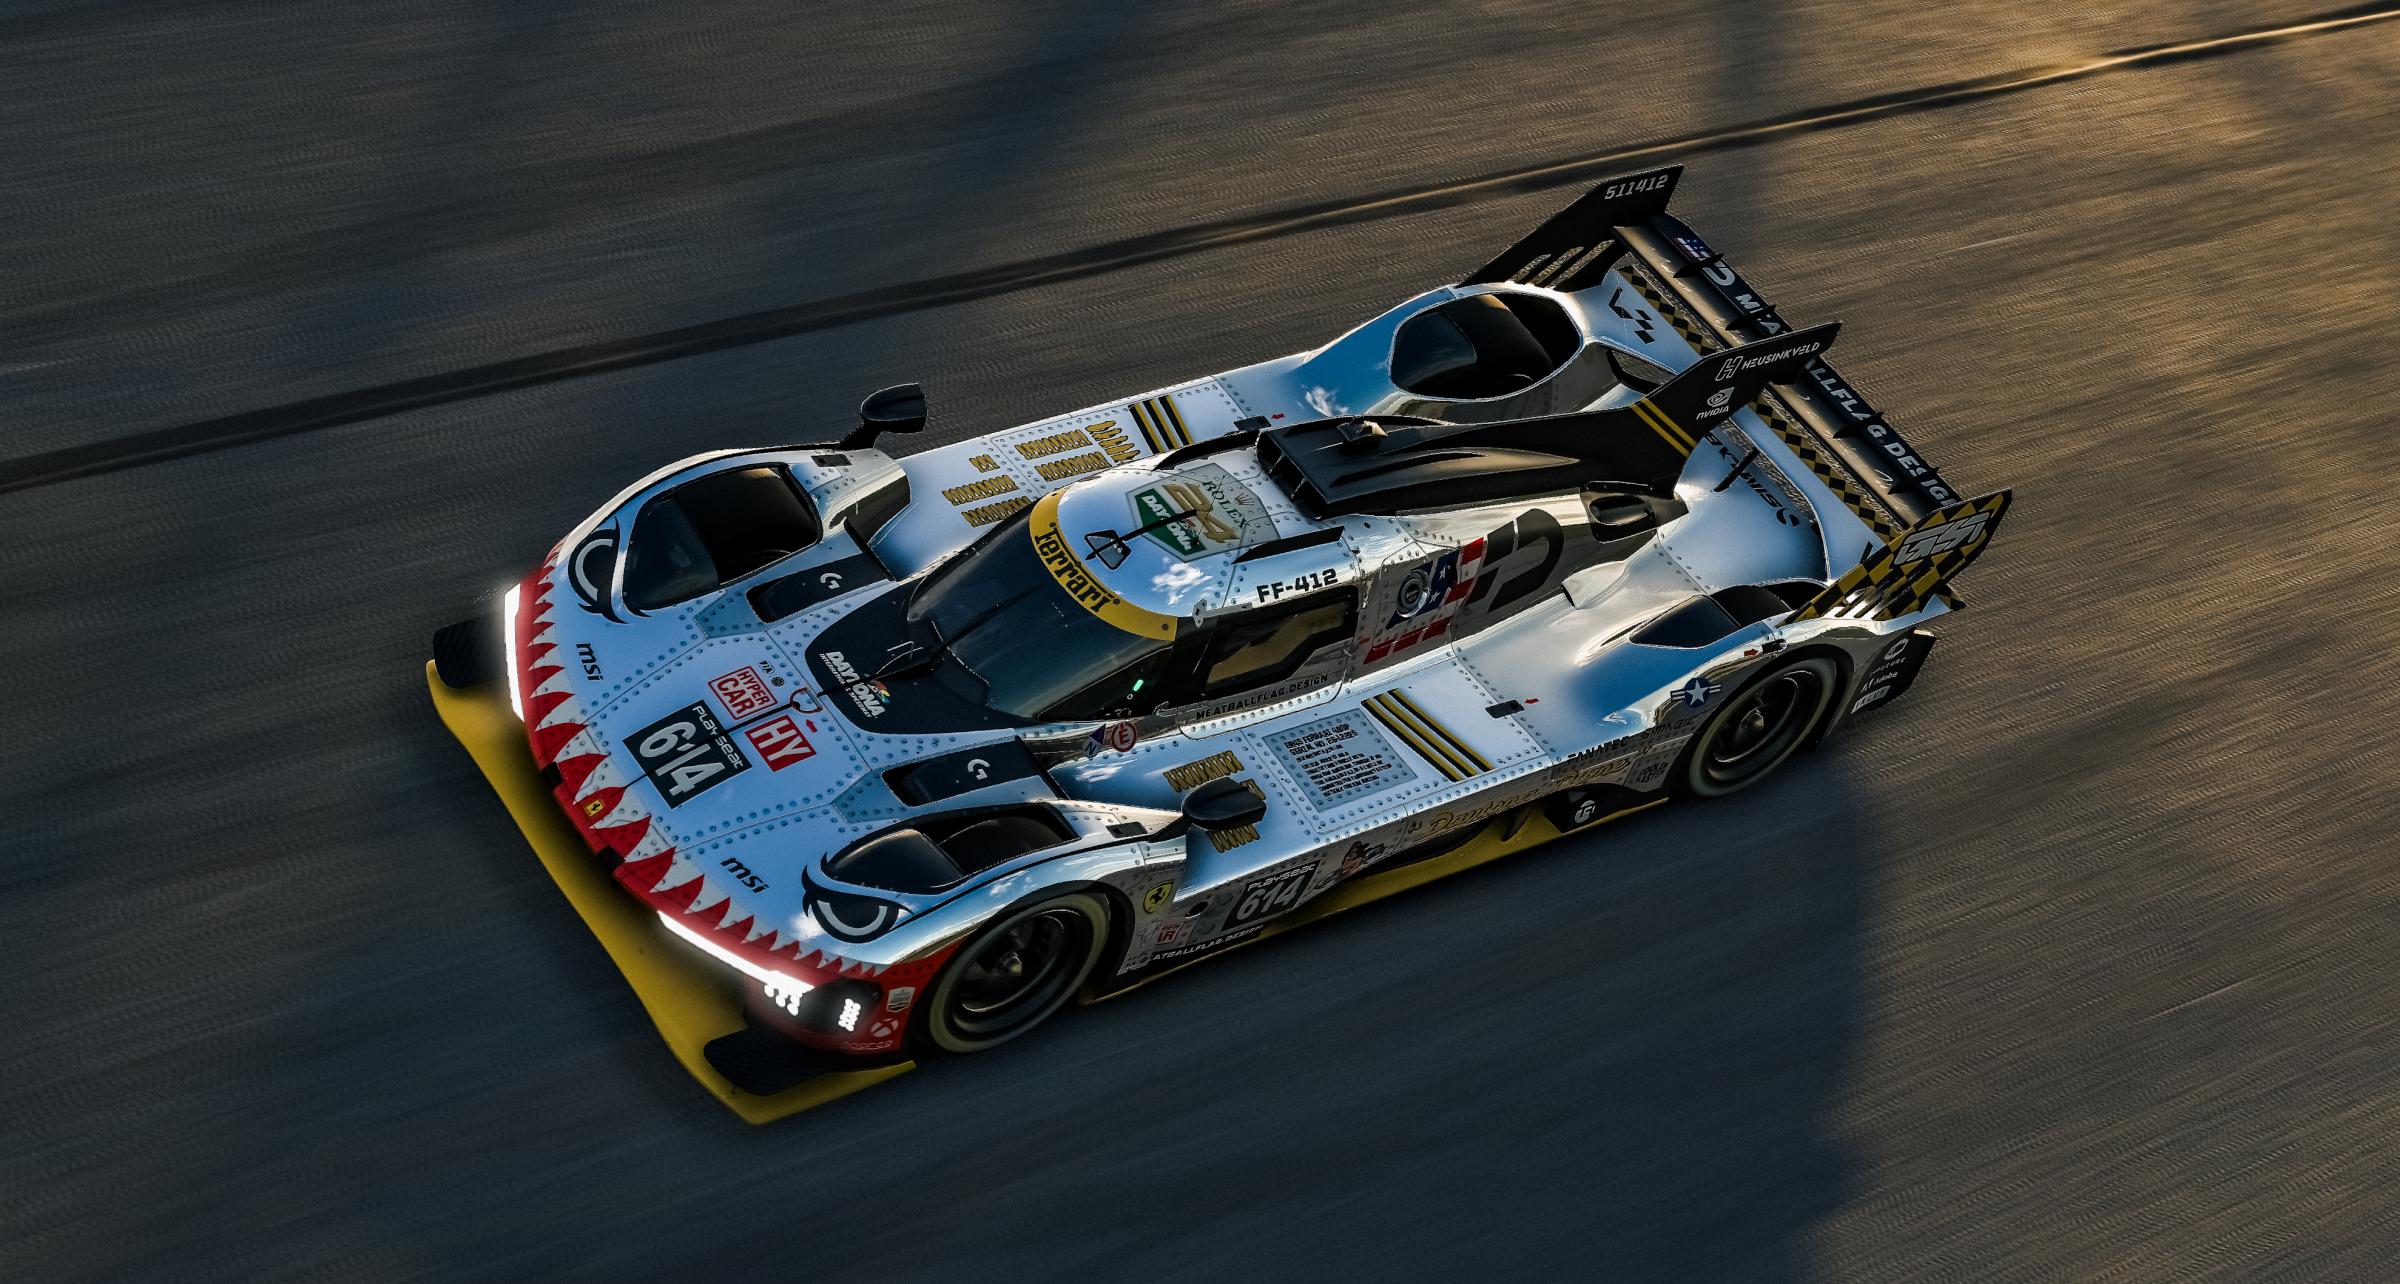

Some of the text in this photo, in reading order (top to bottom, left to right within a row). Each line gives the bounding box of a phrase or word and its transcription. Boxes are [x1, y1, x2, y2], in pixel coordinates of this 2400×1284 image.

[1604, 174, 1668, 199] 511412
[1742, 342, 1820, 370] HEUSINKVELD
[1141, 494, 1192, 551] DAYONA
[1161, 482, 1241, 545] 24
[1202, 479, 1251, 528] ROLEX
[1035, 523, 1121, 613] Ferrari
[1256, 569, 1337, 602] FF-412
[576, 643, 604, 682] msi
[716, 675, 758, 717] CAR
[737, 670, 773, 707] HYPER
[1196, 674, 1328, 721] MEATBALLFLAG.DESIGN
[638, 722, 727, 798] 614
[749, 716, 807, 764] HY
[719, 857, 771, 895] msi
[1236, 875, 1300, 921] 614
